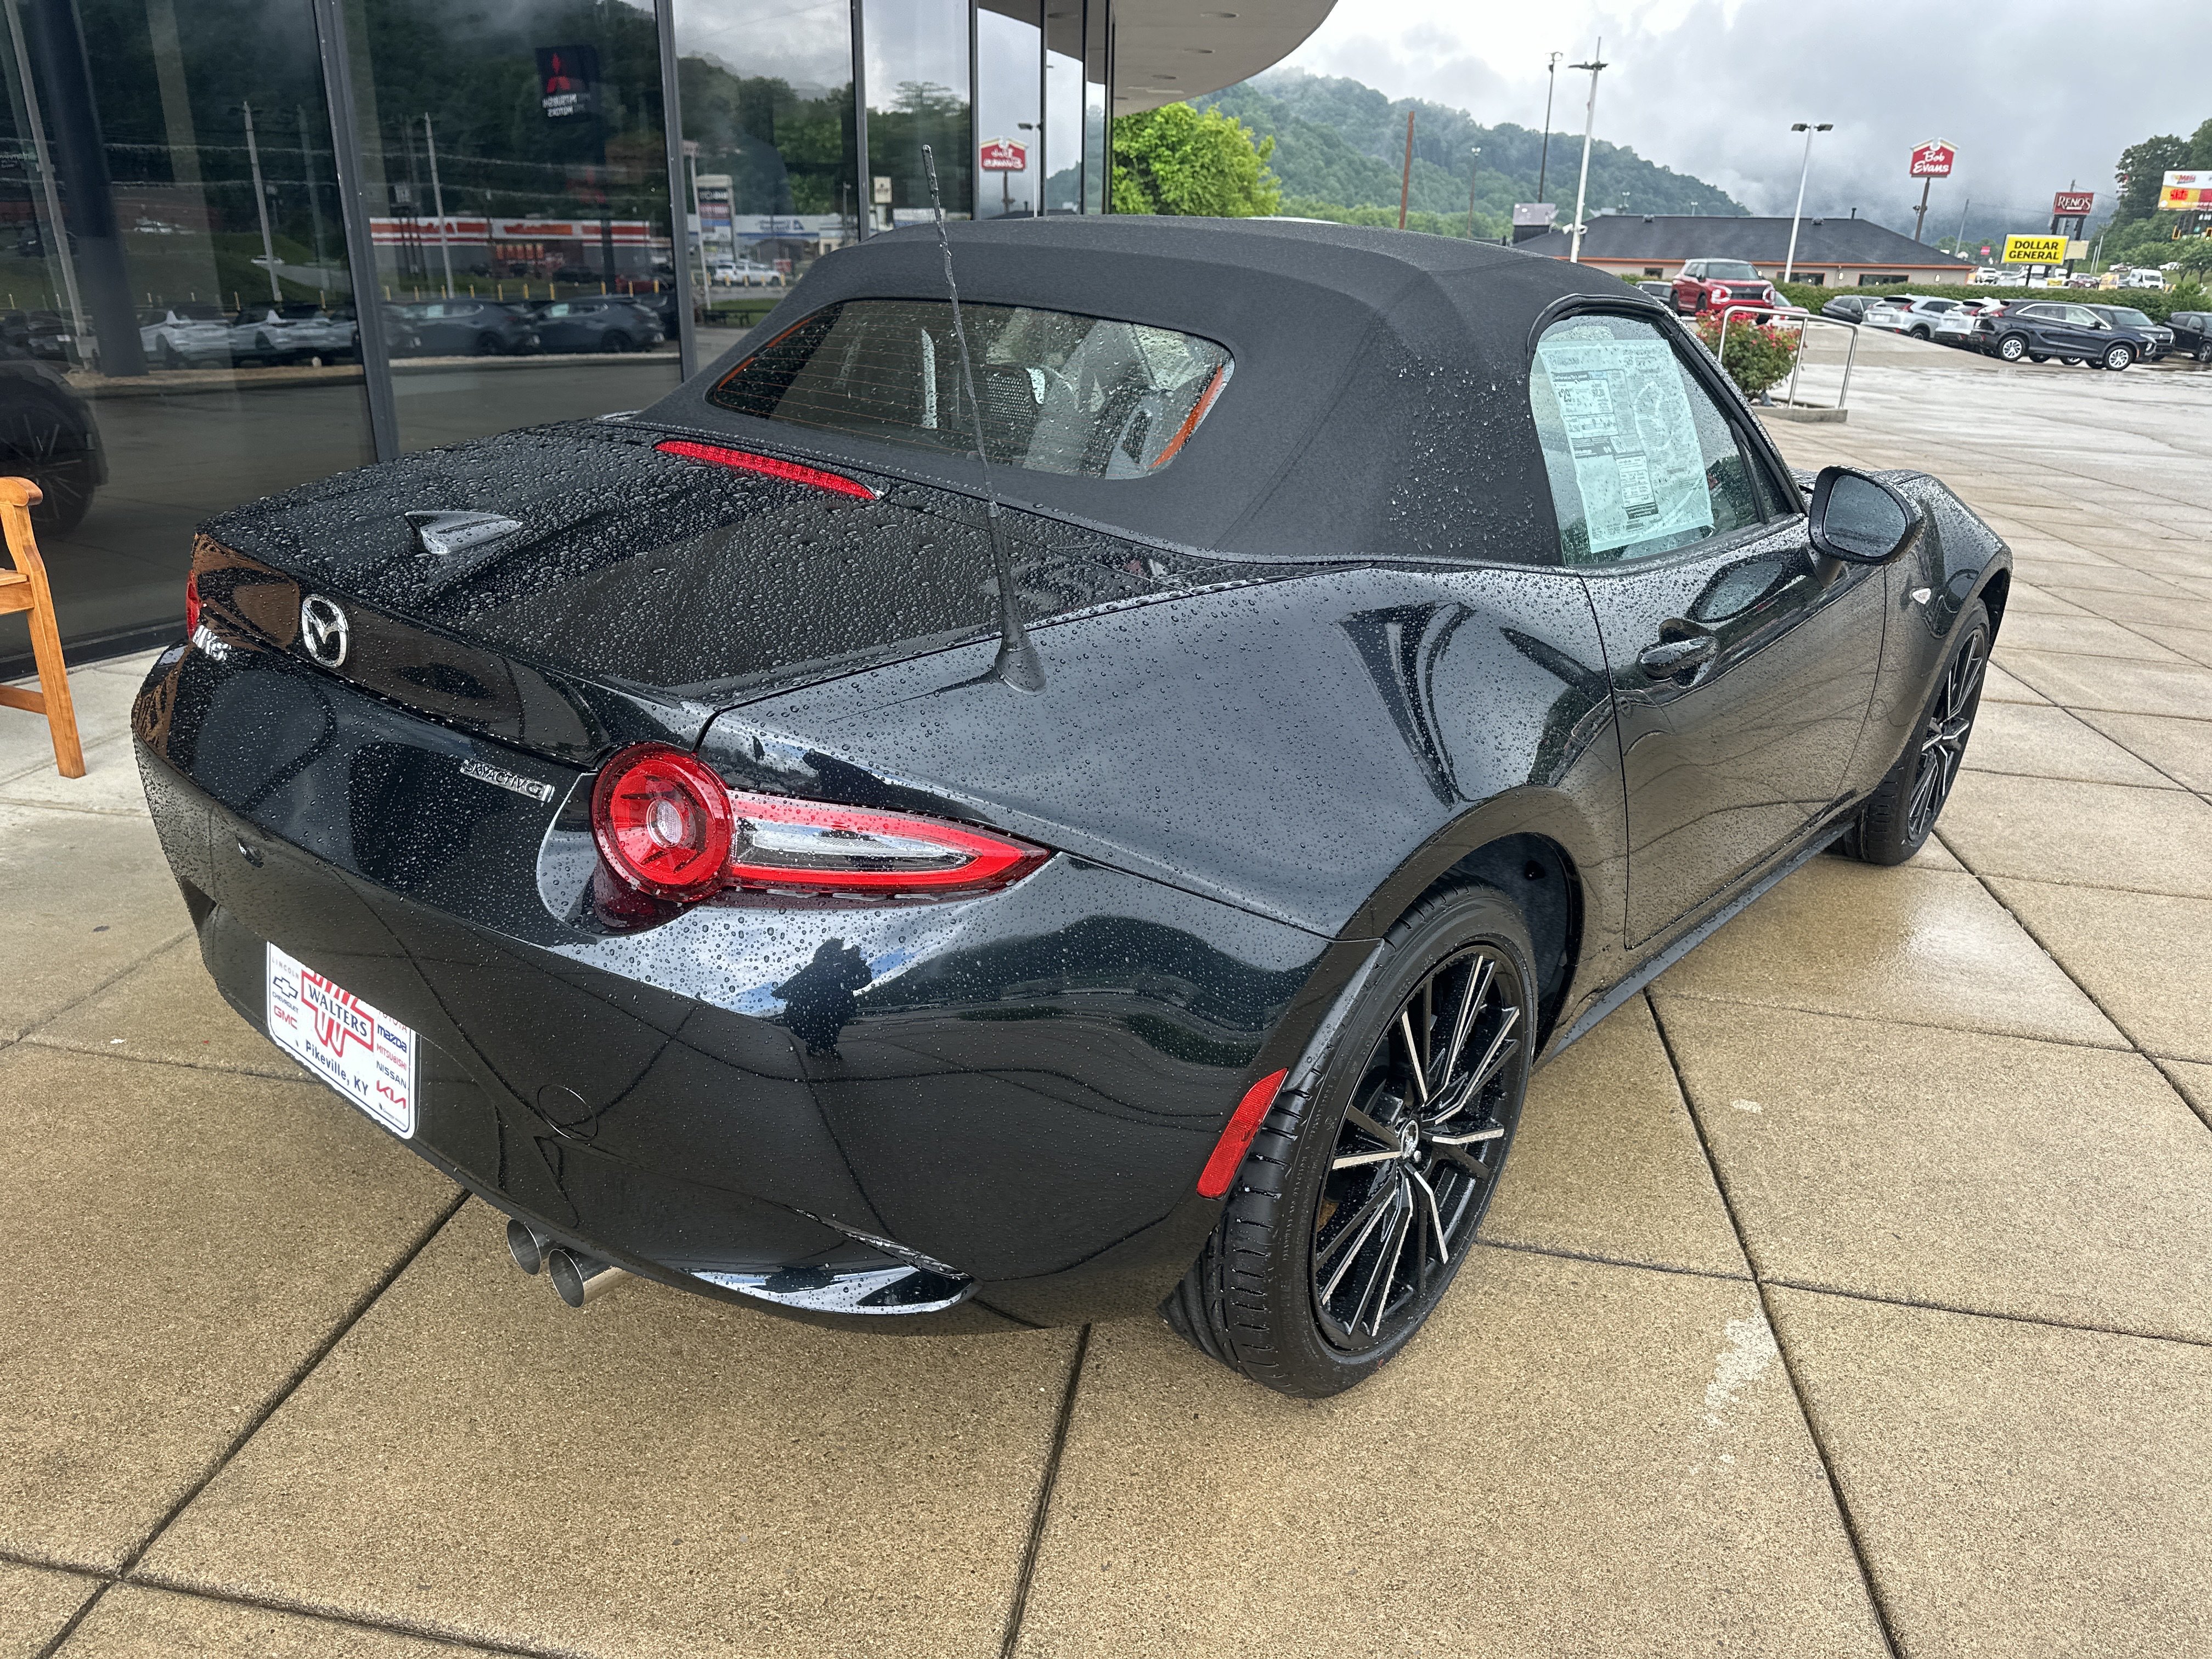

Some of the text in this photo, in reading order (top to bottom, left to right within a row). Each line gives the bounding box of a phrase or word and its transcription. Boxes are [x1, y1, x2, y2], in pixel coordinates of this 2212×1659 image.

[1912, 160, 1949, 174] Evans
[1923, 150, 1945, 162] Bob
[2008, 250, 2059, 261] GENERAL
[2014, 240, 2059, 250] DOLLAR
[272, 957, 300, 980] LINCOLN
[272, 991, 299, 1014] CHEVROLET
[308, 984, 367, 1037] WALTERS
[274, 1005, 298, 1030] GMC
[306, 1039, 369, 1096] Pikeville, KY
[376, 1043, 407, 1071] MITSUBISHI
[376, 1060, 407, 1089] NISSAN
